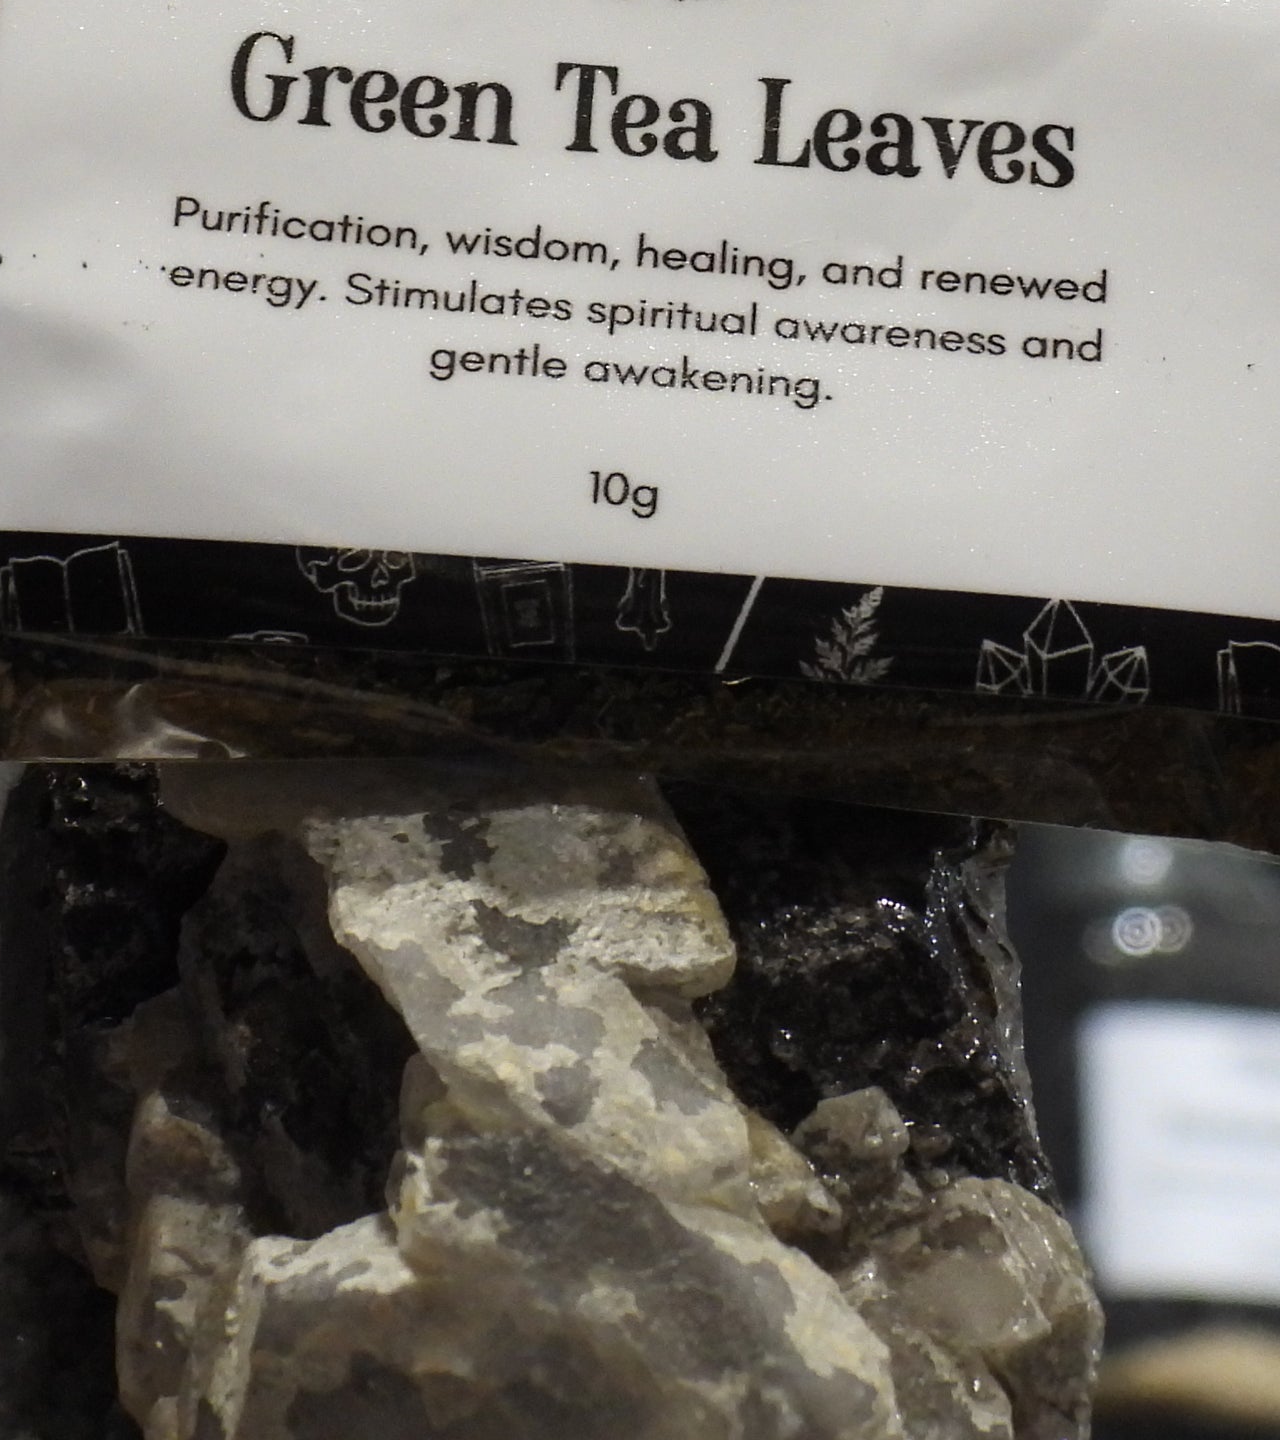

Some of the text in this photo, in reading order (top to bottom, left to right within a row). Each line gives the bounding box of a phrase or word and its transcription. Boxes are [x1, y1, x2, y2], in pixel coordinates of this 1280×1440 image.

[230, 31, 1076, 190] Green Tea Leaves
[173, 195, 1108, 305] Purification, wisdom, healing, and renewed
[169, 265, 1103, 364] energy. Stimulates spiritual awareness and
[429, 343, 833, 411] gentle awakening.
[589, 470, 659, 520] 10g
